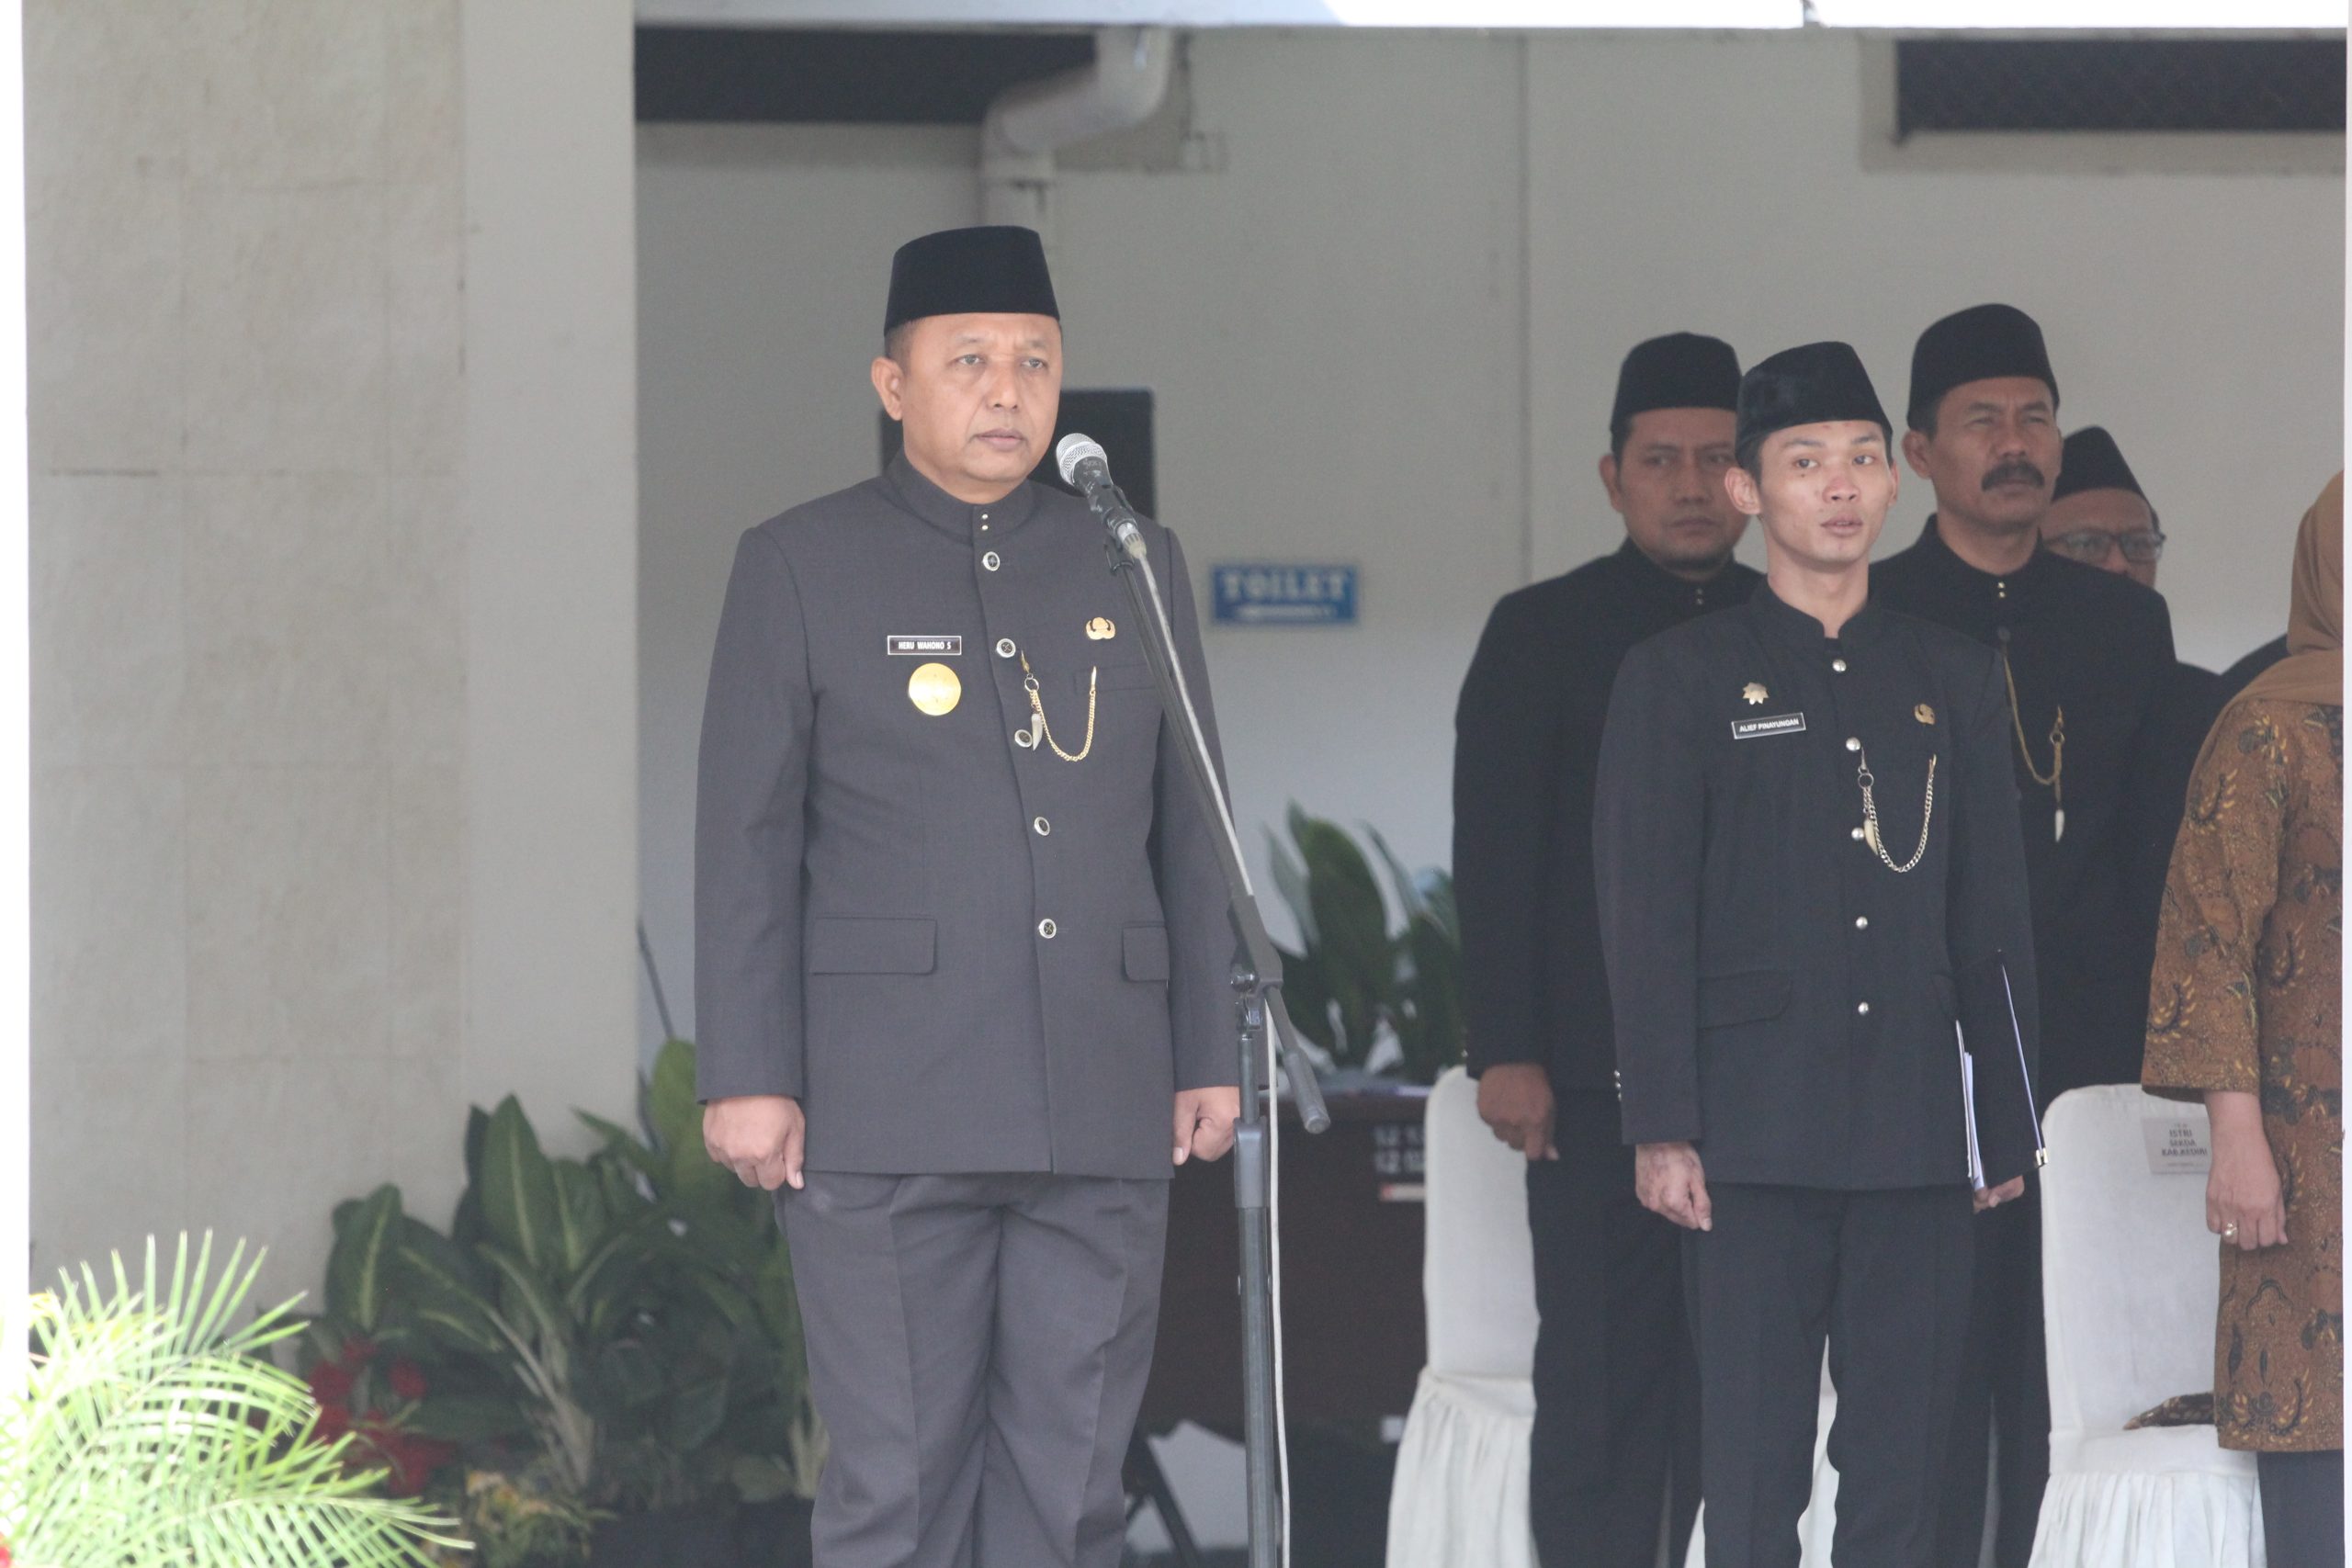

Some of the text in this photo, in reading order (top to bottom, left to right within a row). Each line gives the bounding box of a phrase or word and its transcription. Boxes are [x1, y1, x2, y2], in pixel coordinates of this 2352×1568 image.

[1222, 571, 1345, 600] TOILET
[898, 641, 952, 650] HERU WAHONO S
[1739, 717, 1800, 733] ALIEF PINAYUNGAN
[2169, 1129, 2193, 1138] ISTRI
[2169, 1139, 2197, 1147] SEKDA
